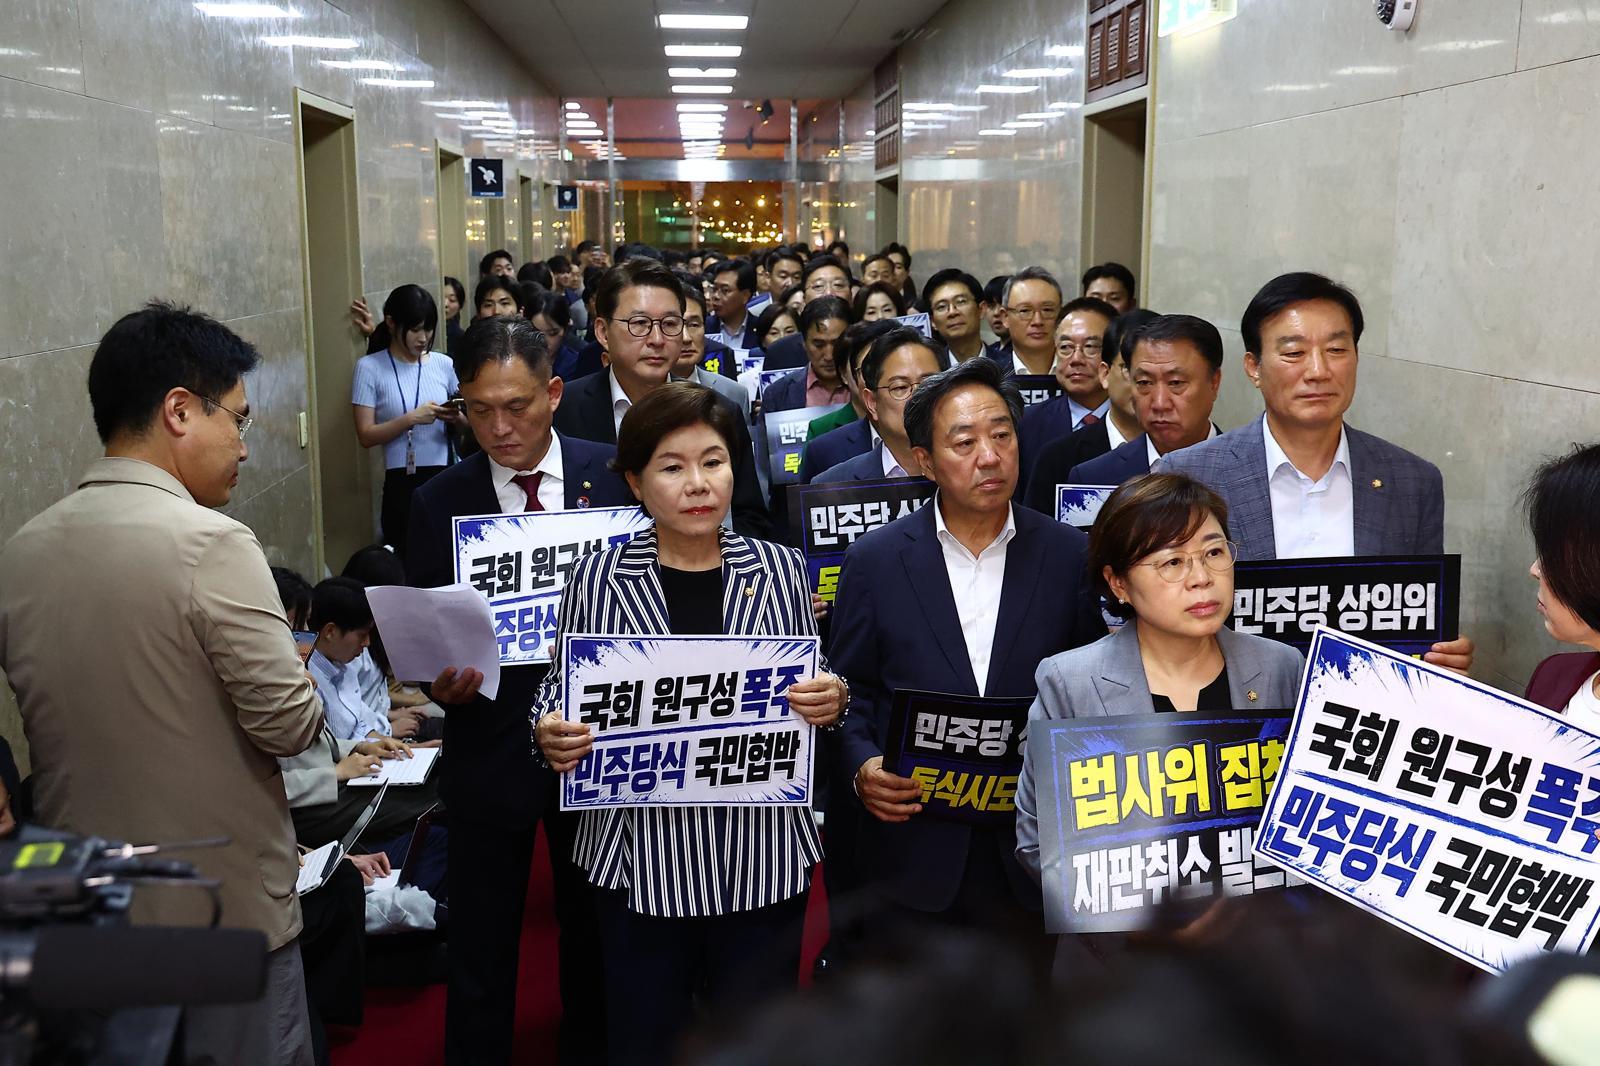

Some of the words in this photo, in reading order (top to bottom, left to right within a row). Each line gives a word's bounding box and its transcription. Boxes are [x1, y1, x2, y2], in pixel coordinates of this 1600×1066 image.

[470, 551, 522, 598] 국회
[1233, 585, 1331, 634] 민주당
[1337, 582, 1437, 632] 상임위
[579, 680, 643, 732] 국회
[651, 671, 740, 726] 원구성
[914, 711, 1014, 757] 민주당
[572, 740, 689, 802] 민주당식
[694, 730, 801, 788] 국민협박
[910, 766, 1020, 812] 독식시도
[1069, 743, 1212, 831] 법사위
[1309, 701, 1400, 783] 국회
[1396, 727, 1533, 819] 원구성
[1072, 836, 1215, 915] 재판취소
[1269, 785, 1438, 898] 민주당식
[1425, 837, 1595, 950] 국민협박
